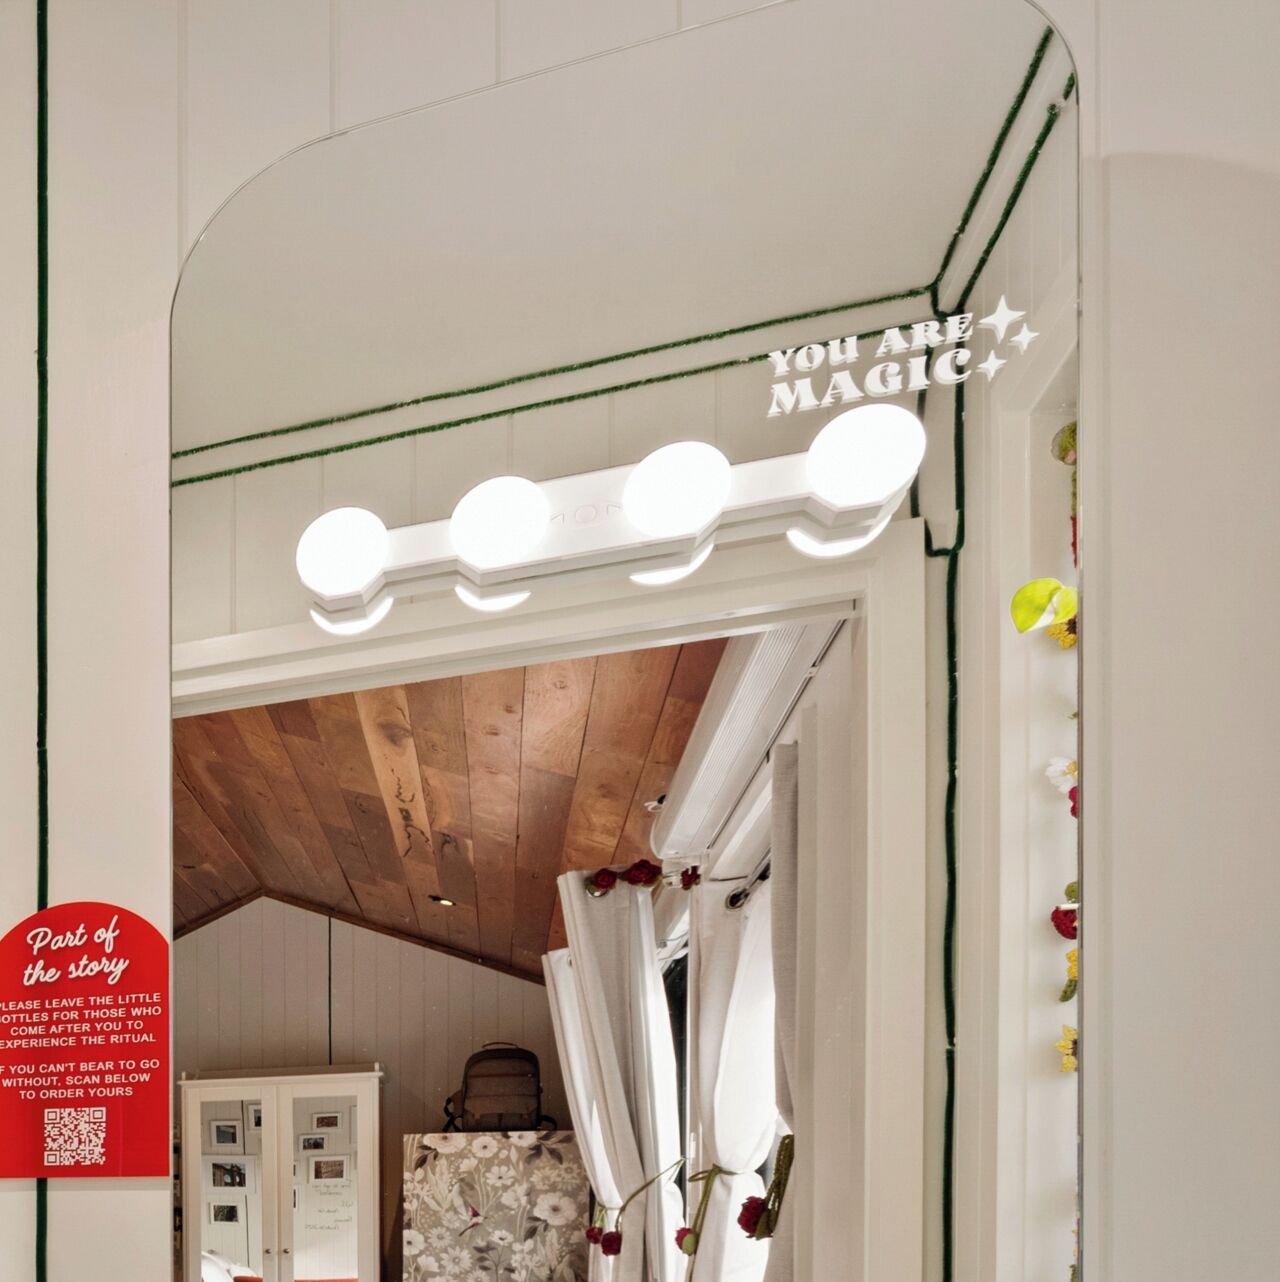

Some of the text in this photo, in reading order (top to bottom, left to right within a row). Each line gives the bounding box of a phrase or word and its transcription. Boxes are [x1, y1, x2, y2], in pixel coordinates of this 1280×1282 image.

[768, 312, 975, 377] YOU ARE
[766, 348, 971, 418] MAGIC
[26, 914, 120, 955] Part of
[23, 954, 129, 986] the story
[45, 997, 84, 1008] LEAVE
[88, 996, 113, 1006] THE
[118, 993, 161, 1004] LITTLE
[53, 1010, 79, 1021] FOR
[83, 1007, 128, 1019] THOSE
[130, 1006, 162, 1017] WHO
[10, 1020, 143, 1036] COME AFTER YOU TO
[80, 1035, 106, 1045] THE
[110, 1033, 156, 1044] RITUAL
[9, 1063, 36, 1075] YOU
[38, 1062, 76, 1073] CAN'T
[79, 1060, 114, 1072] BEAR
[118, 1059, 137, 1070] TO
[140, 1058, 160, 1069] GO
[65, 1074, 100, 1085] SCAN
[104, 1072, 151, 1083] BELOW
[19, 1086, 133, 1100] TO ORDER YOURS
